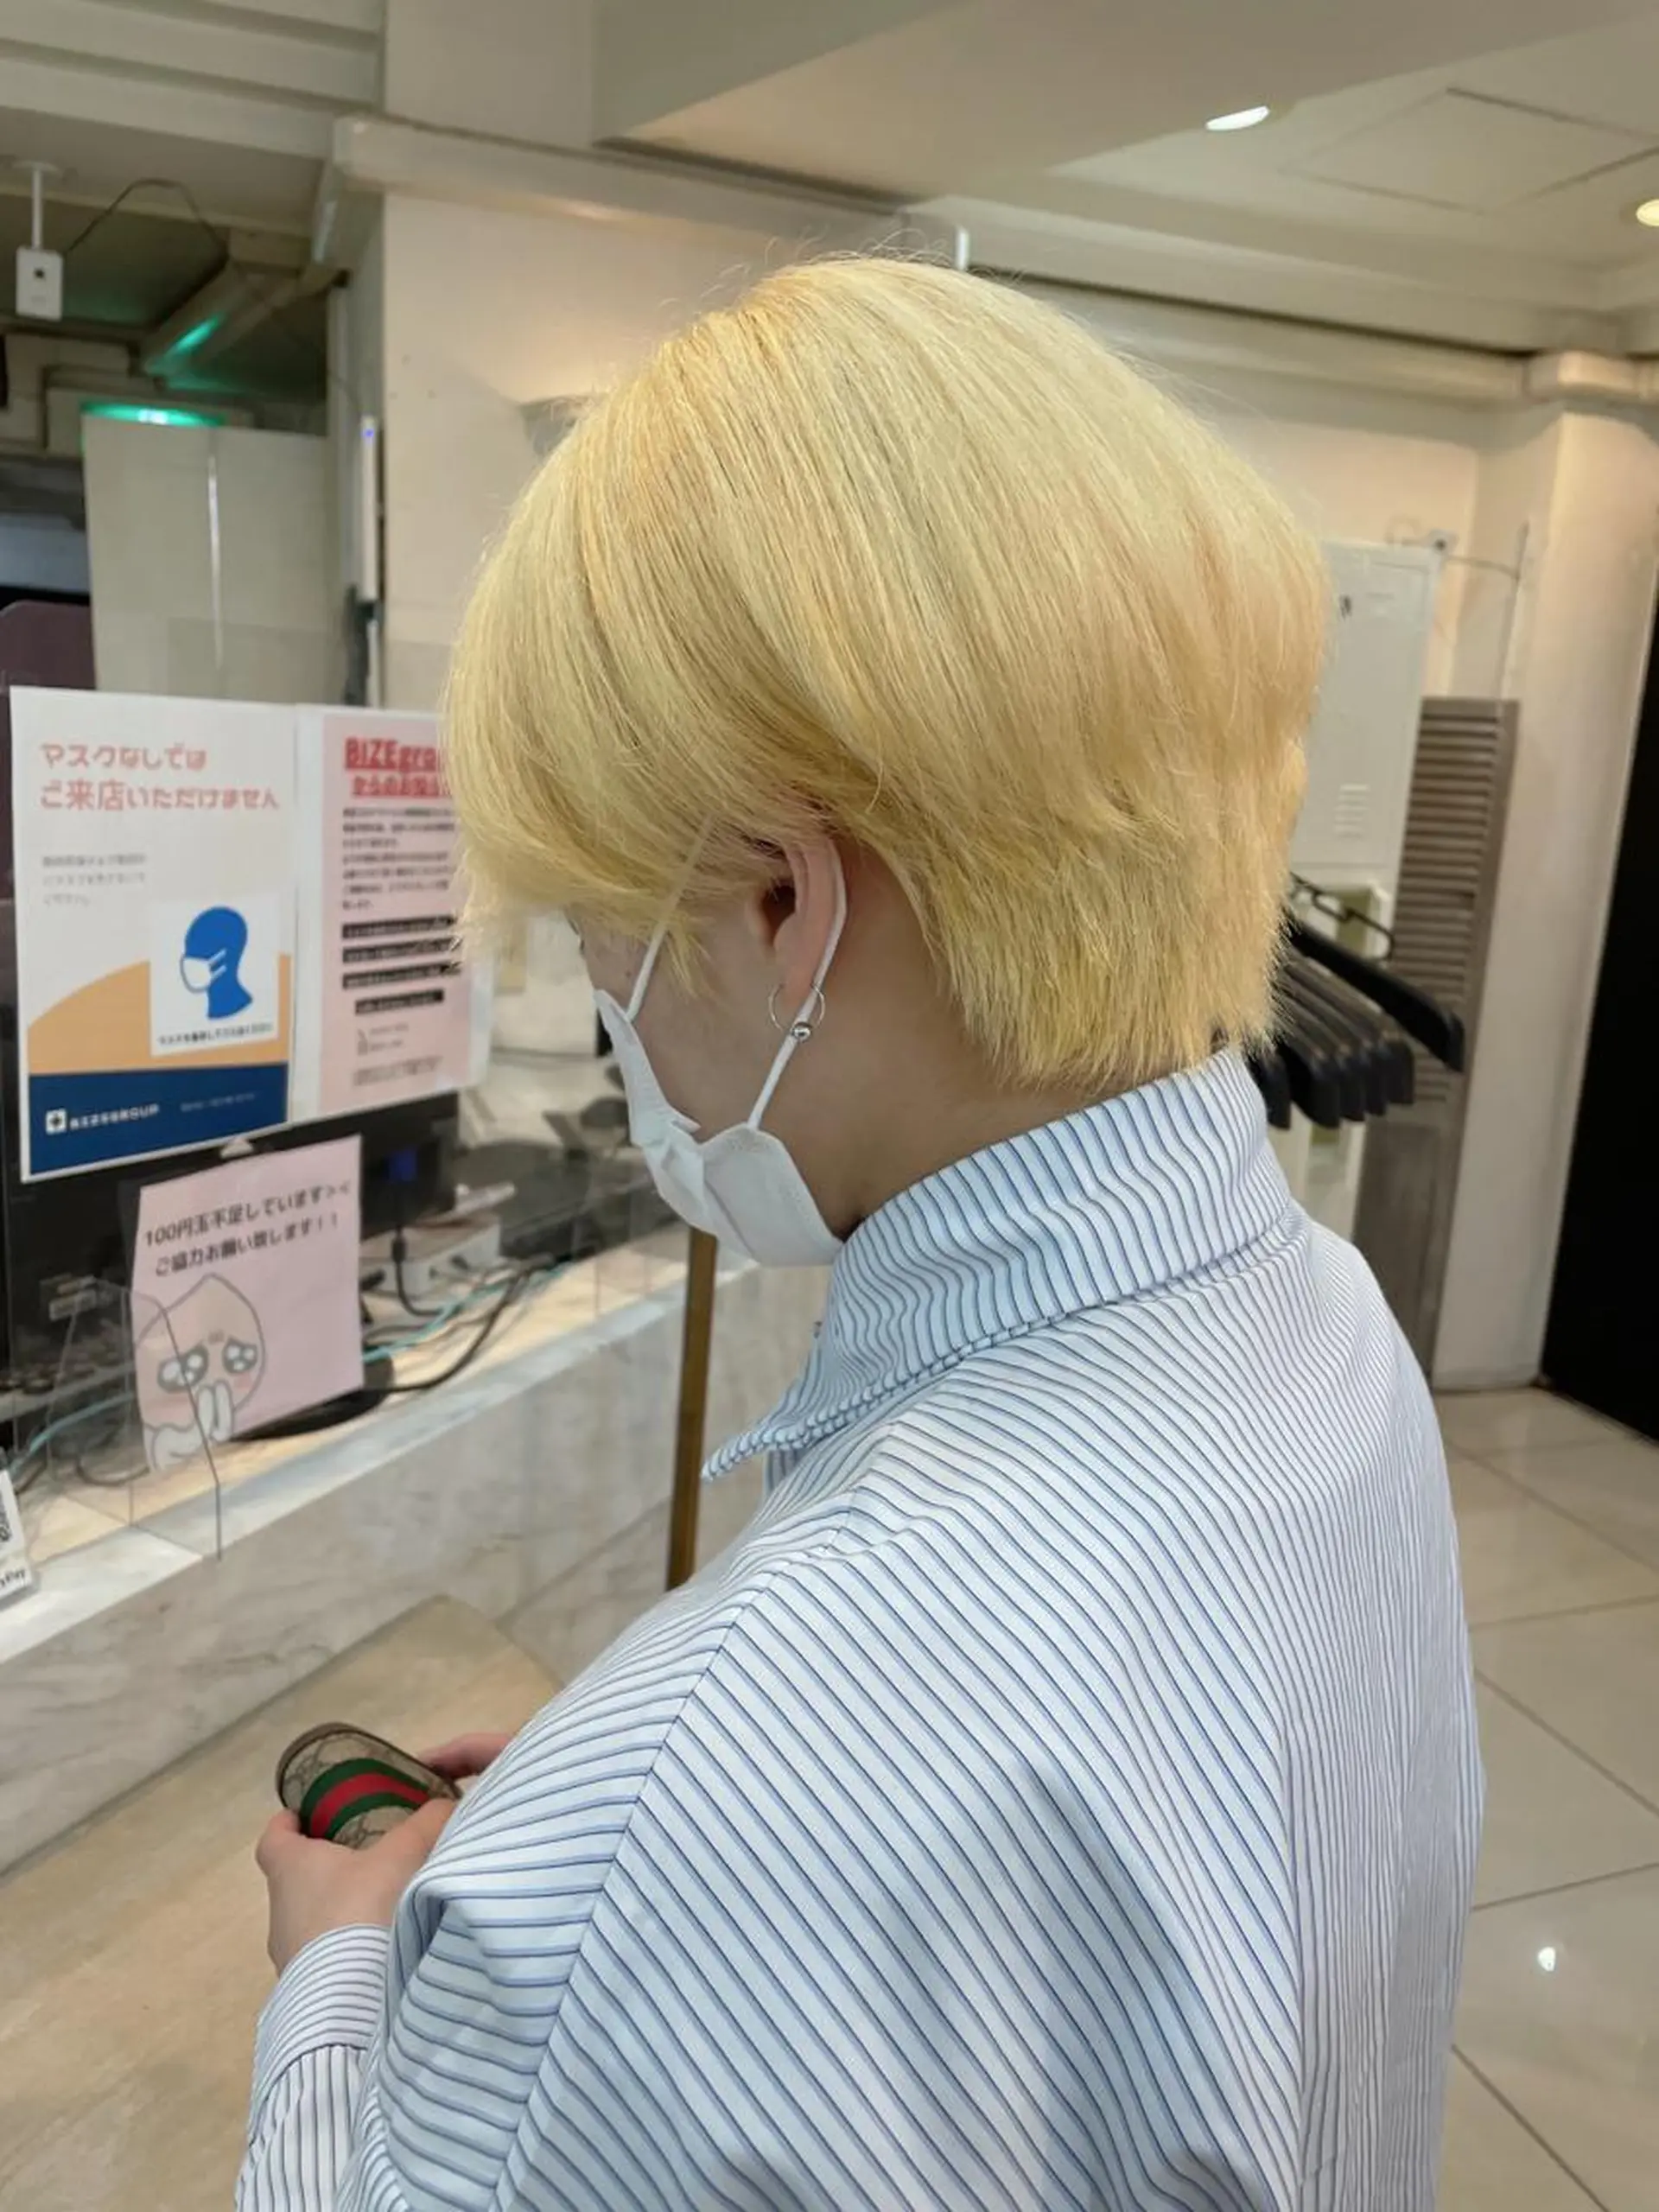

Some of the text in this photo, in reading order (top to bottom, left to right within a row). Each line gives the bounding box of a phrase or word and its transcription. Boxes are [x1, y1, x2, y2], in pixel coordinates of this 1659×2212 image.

[41, 742, 207, 770] マスクなしでは
[41, 779, 280, 810] ご来店いただけません
